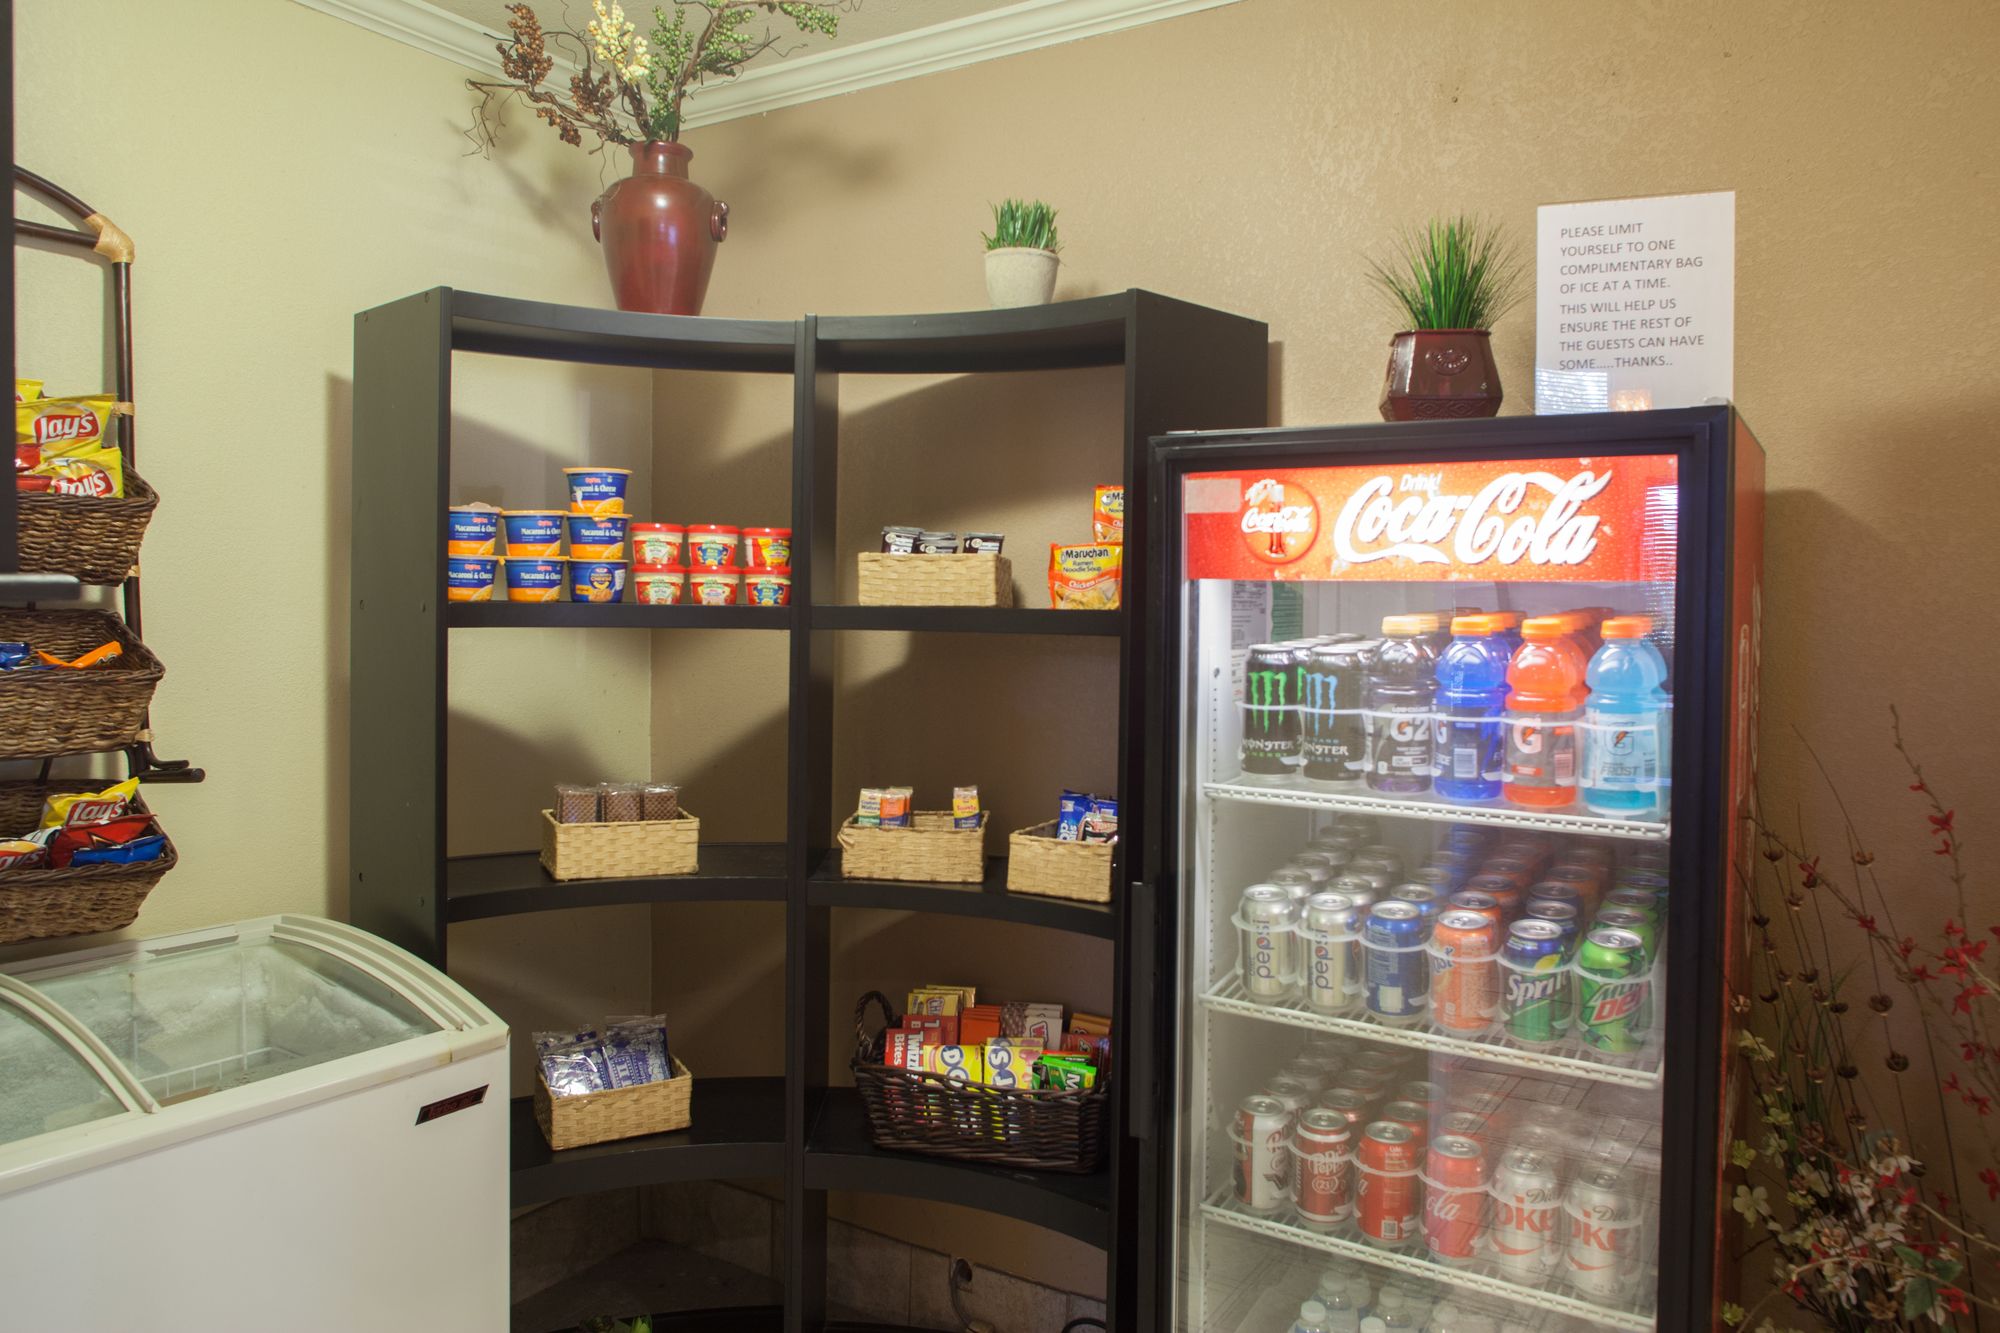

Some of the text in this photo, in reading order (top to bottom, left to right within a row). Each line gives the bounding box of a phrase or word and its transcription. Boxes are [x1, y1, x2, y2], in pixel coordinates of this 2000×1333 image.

[1560, 223, 1644, 239] PLEASE LIMIT
[1560, 239, 1676, 257] YOURSELF TO ONE
[1560, 256, 1704, 276] COMPLIMENTARY BAG
[1560, 278, 1671, 294] OF ICE AT A TIME.
[1560, 298, 1677, 315] THIS WILL HELP US
[1560, 316, 1693, 334] ENSURE THE REST OF
[1560, 334, 1705, 352] THE GUESTS CAN HAVE
[39, 413, 95, 444] Lay's
[1333, 469, 1613, 566] Coca-Cola
[1065, 548, 1109, 559] Maruchan
[68, 798, 126, 825] Lay's
[1256, 919, 1275, 979] pepsi
[1314, 928, 1334, 990] pepsi
[894, 1033, 905, 1066] Bites
